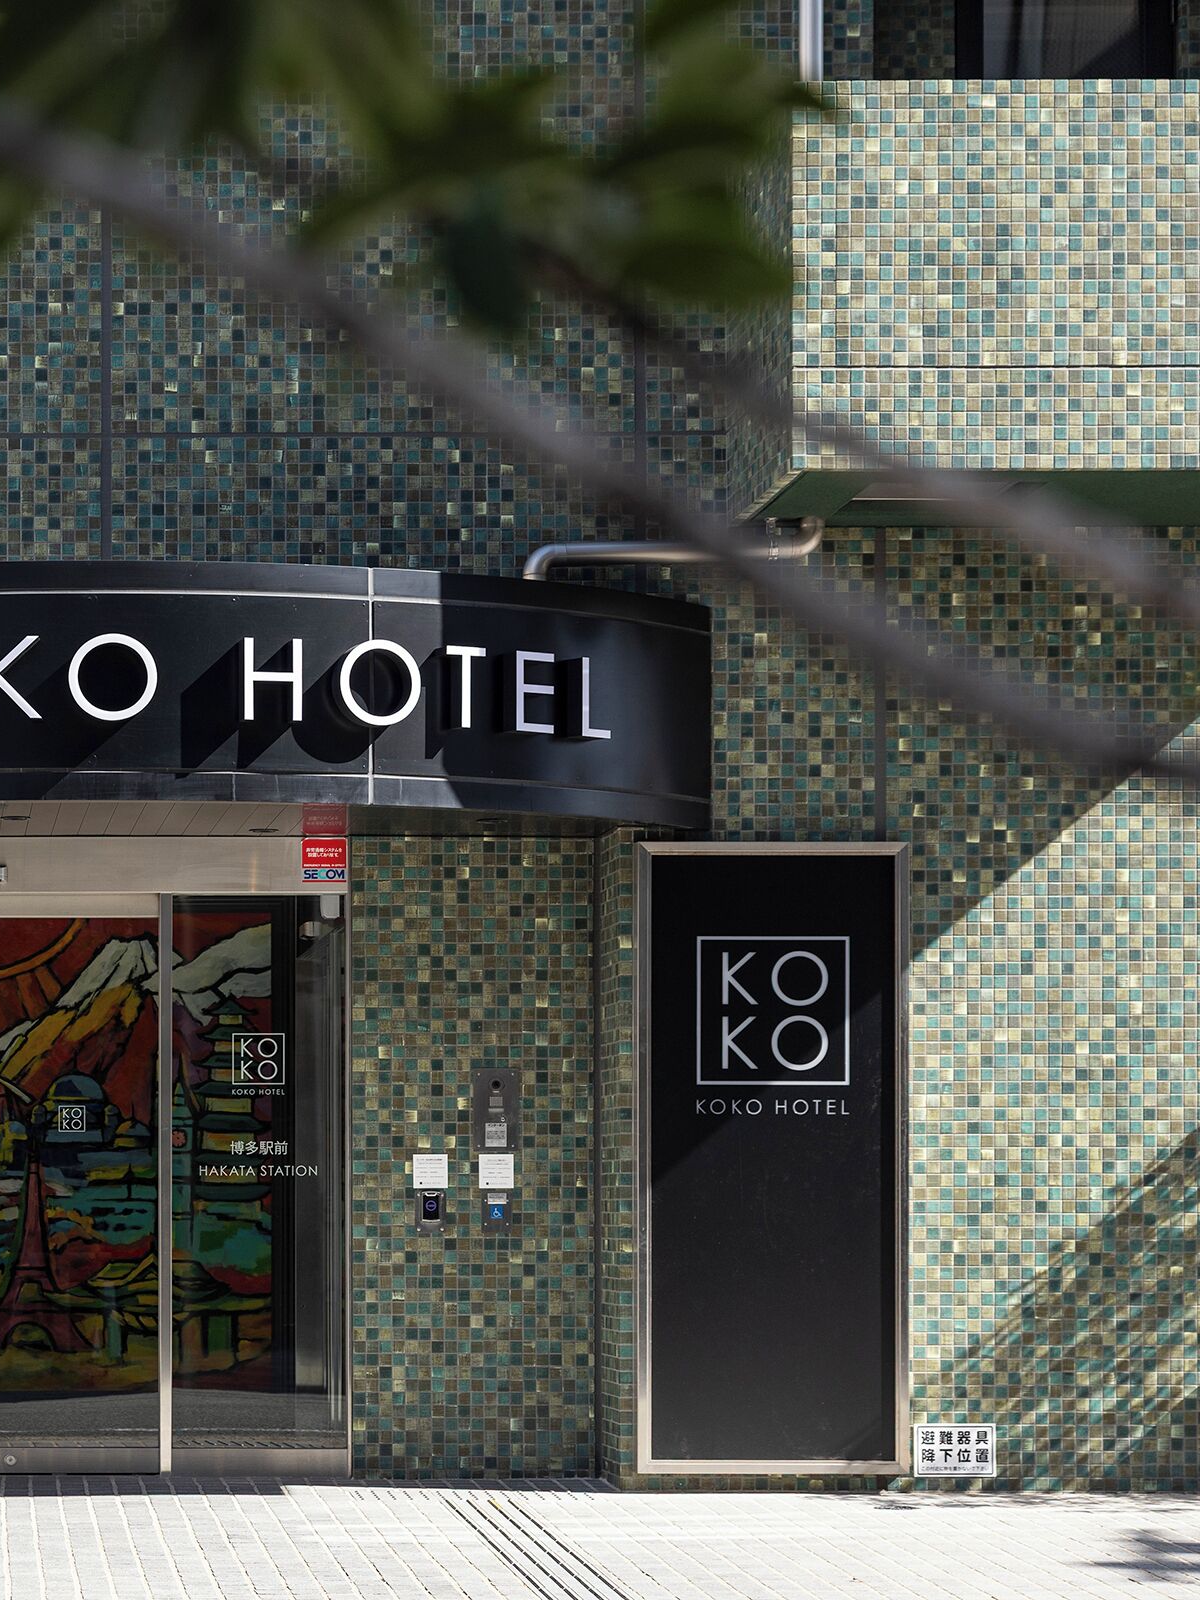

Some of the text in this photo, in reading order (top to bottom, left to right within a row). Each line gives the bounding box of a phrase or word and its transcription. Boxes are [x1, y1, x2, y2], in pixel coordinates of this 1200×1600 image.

[243, 636, 612, 740] HOTEL
[304, 869, 345, 879] SECOM
[722, 950, 829, 1007] KO
[240, 1037, 278, 1058] KO
[722, 1014, 829, 1071] KO
[240, 1059, 278, 1080] KO
[231, 1088, 286, 1096] KOKO HOTEL
[62, 1107, 82, 1119] KO
[695, 1099, 850, 1115] KOKO HOTEL
[62, 1118, 82, 1130] KO
[230, 1140, 289, 1156] 博多駅前
[198, 1165, 318, 1177] HAKATA STATION
[921, 1430, 989, 1445] 避難器具
[921, 1448, 990, 1463] 降下位置
